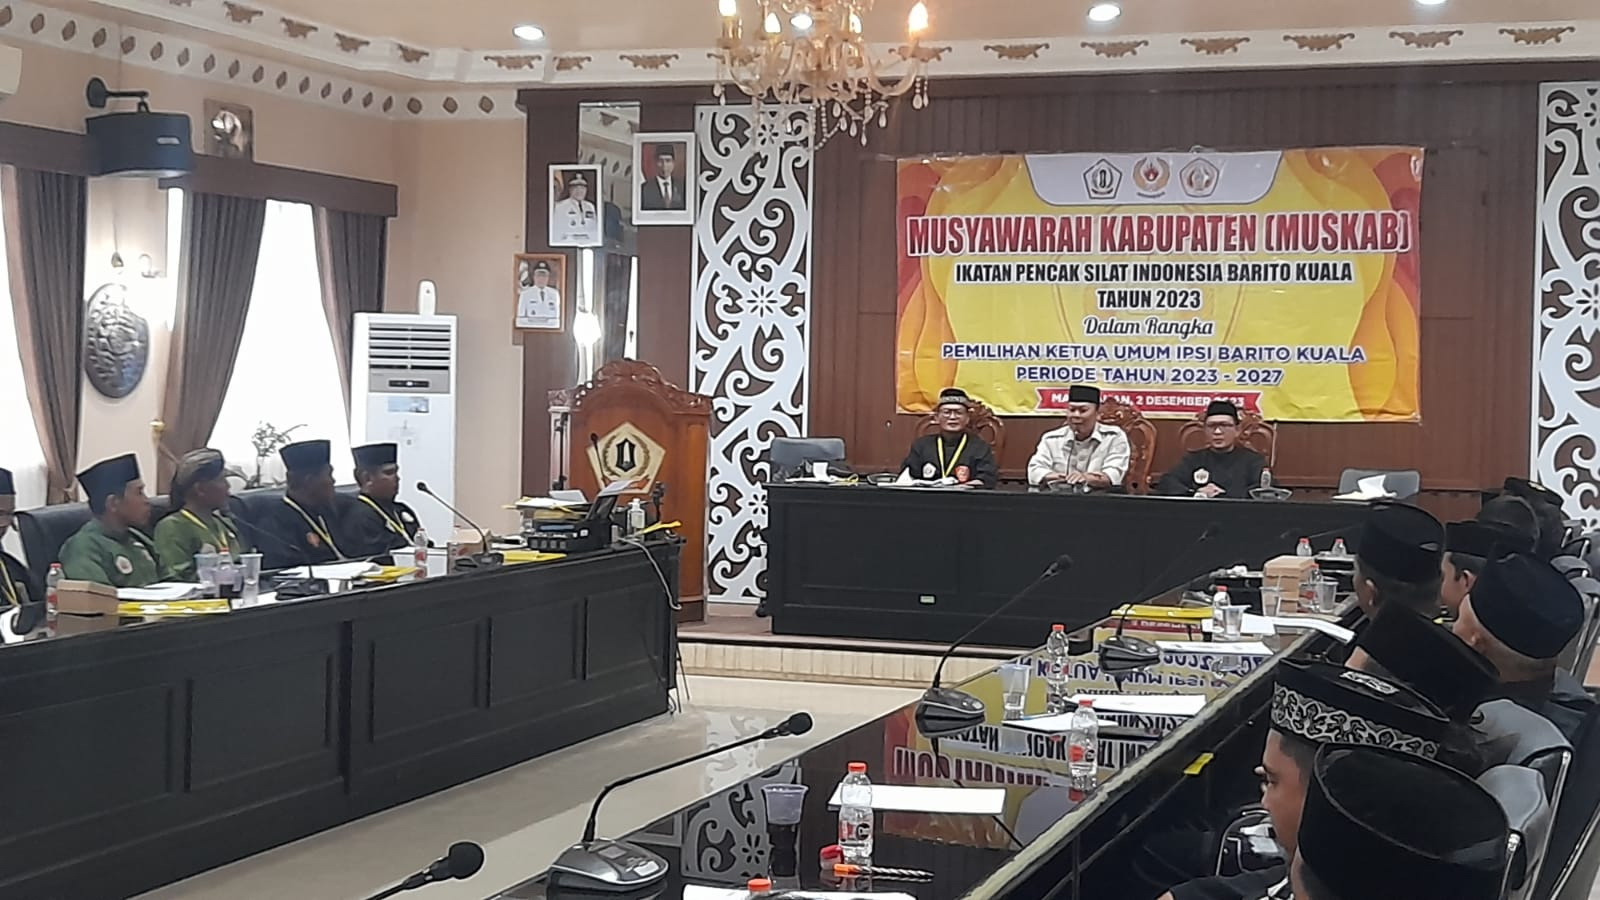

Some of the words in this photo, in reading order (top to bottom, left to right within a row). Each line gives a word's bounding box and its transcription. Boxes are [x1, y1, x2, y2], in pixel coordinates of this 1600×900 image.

[908, 216, 1092, 254] MUSYAWARAH
[1100, 214, 1256, 252] KABUPATEN
[1265, 212, 1409, 251] (MUSKAB)
[956, 264, 1011, 282] IKATAN
[1016, 264, 1080, 282] PENCAK
[1084, 264, 1129, 282] SILAT
[1133, 263, 1222, 282] INDONESIA
[1227, 263, 1291, 281] BARITO
[1296, 263, 1352, 281] KUALA
[1098, 290, 1151, 308] TAHUN
[1156, 290, 1201, 308] 2023
[1084, 317, 1139, 334] Dalam
[1145, 317, 1213, 339] Rangka
[943, 345, 1040, 358] PEMILIHAN
[1047, 345, 1107, 359] KETUA
[1115, 346, 1170, 359] UMUM
[1177, 346, 1211, 360] IPSI
[1218, 347, 1290, 361] BARITO
[1297, 347, 1364, 361] KUALA
[1017, 367, 1096, 380] PERIODE
[1103, 368, 1165, 381] TAHUN
[1171, 368, 1217, 382] 2023
[1237, 369, 1283, 382] 2027
[1136, 395, 1143, 405] 2
[1146, 395, 1211, 406] DESEMBER
